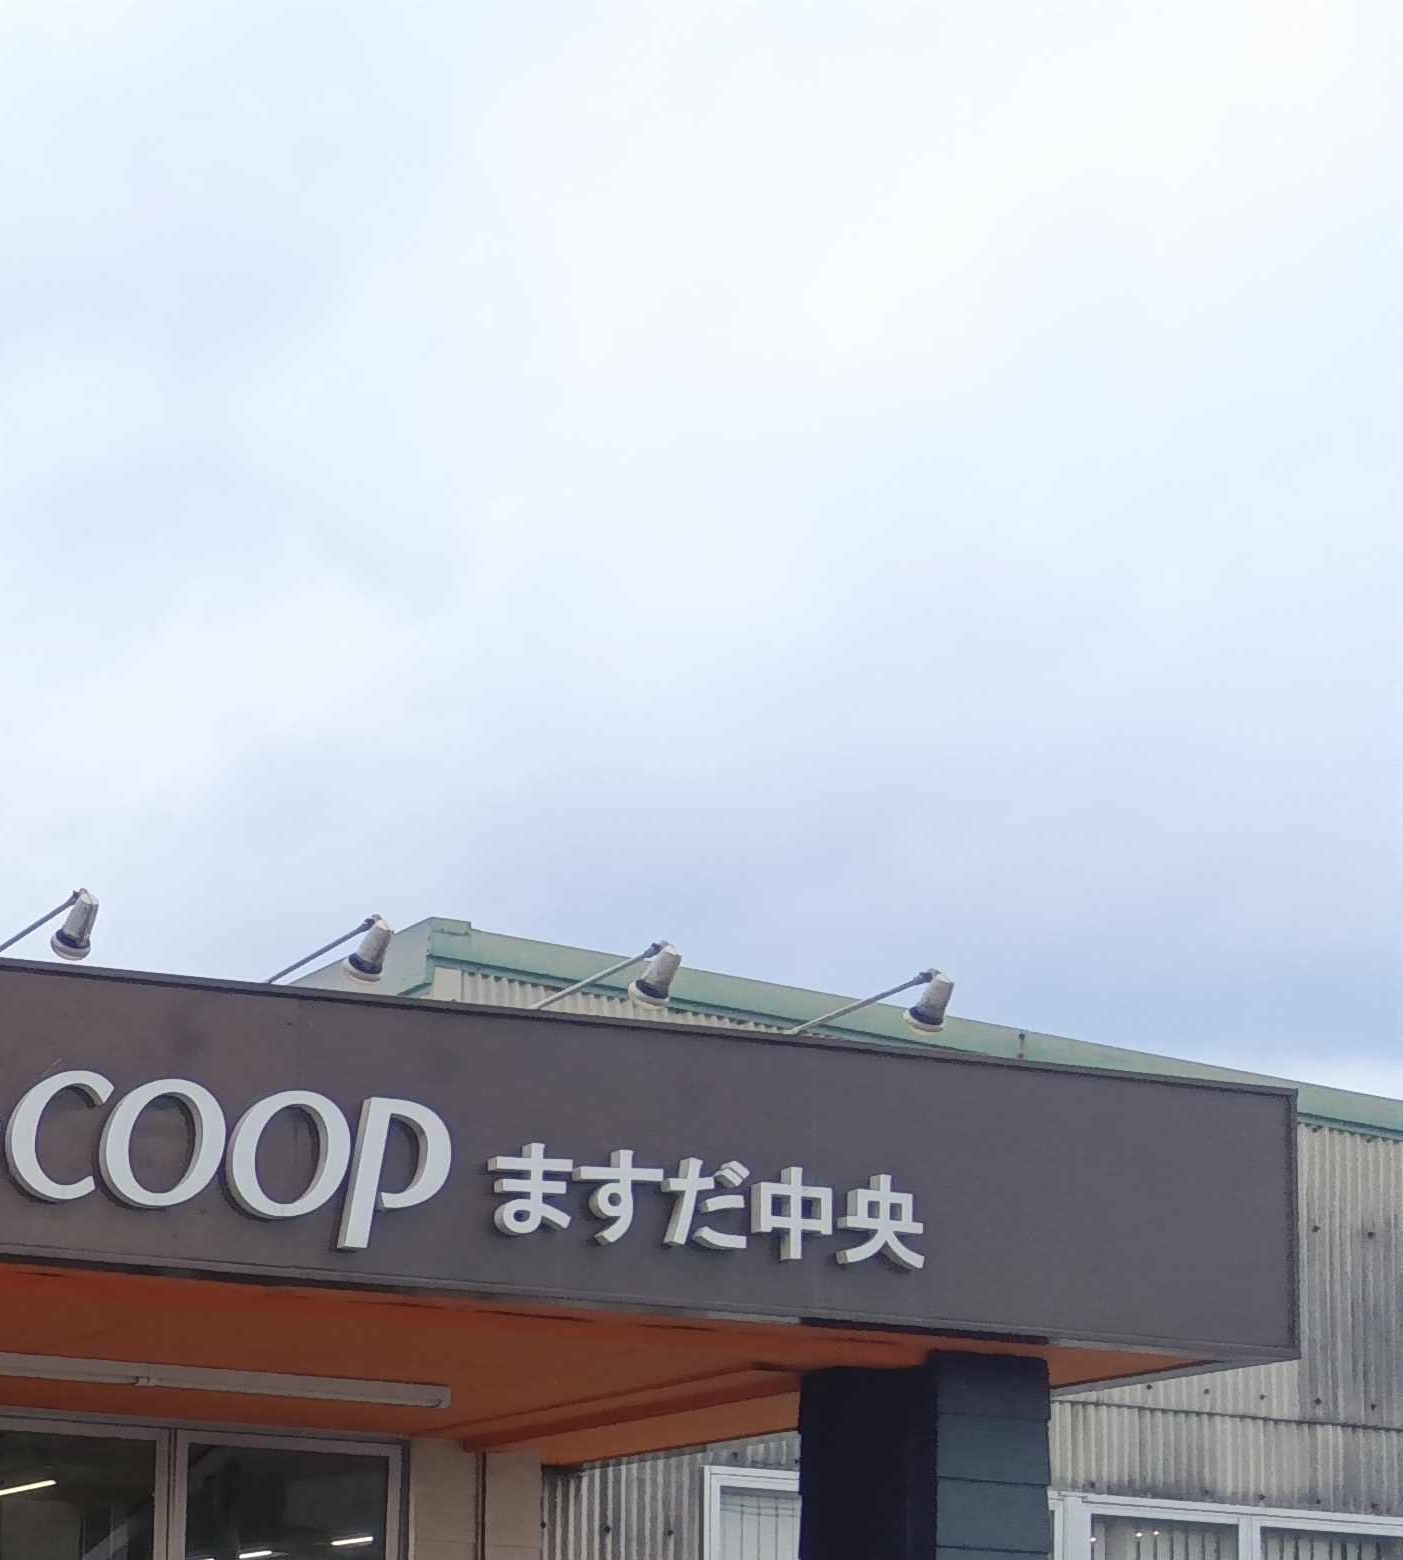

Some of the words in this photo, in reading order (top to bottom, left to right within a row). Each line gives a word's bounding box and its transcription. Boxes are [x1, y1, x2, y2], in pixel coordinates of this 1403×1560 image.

[486, 1141, 925, 1272] ますだ中央
